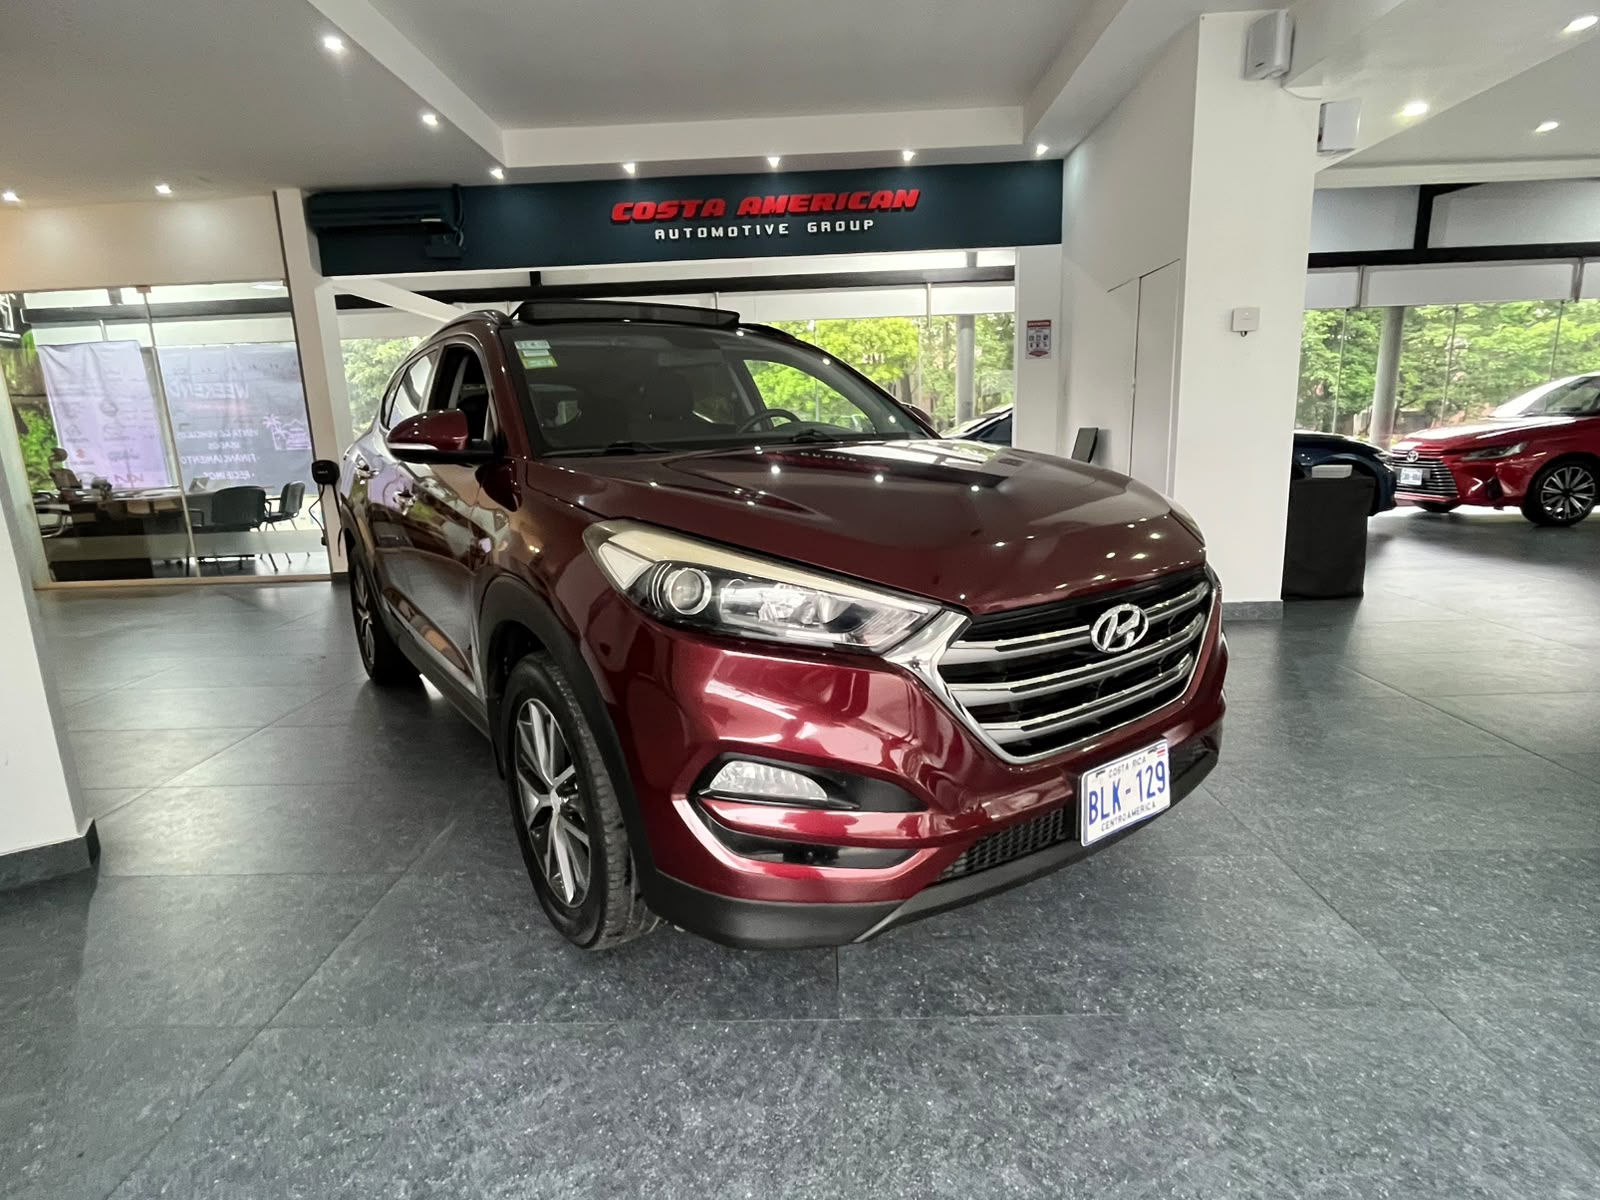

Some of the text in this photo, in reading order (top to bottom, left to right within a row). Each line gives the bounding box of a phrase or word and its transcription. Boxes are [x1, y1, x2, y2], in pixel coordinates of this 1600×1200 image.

[611, 189, 920, 222] COSTA AMERICAN
[655, 219, 875, 240] AUTOMOTIVE GROUP
[1088, 760, 1166, 826] BLK-129
[1101, 801, 1156, 832] CENTROAMERICA
